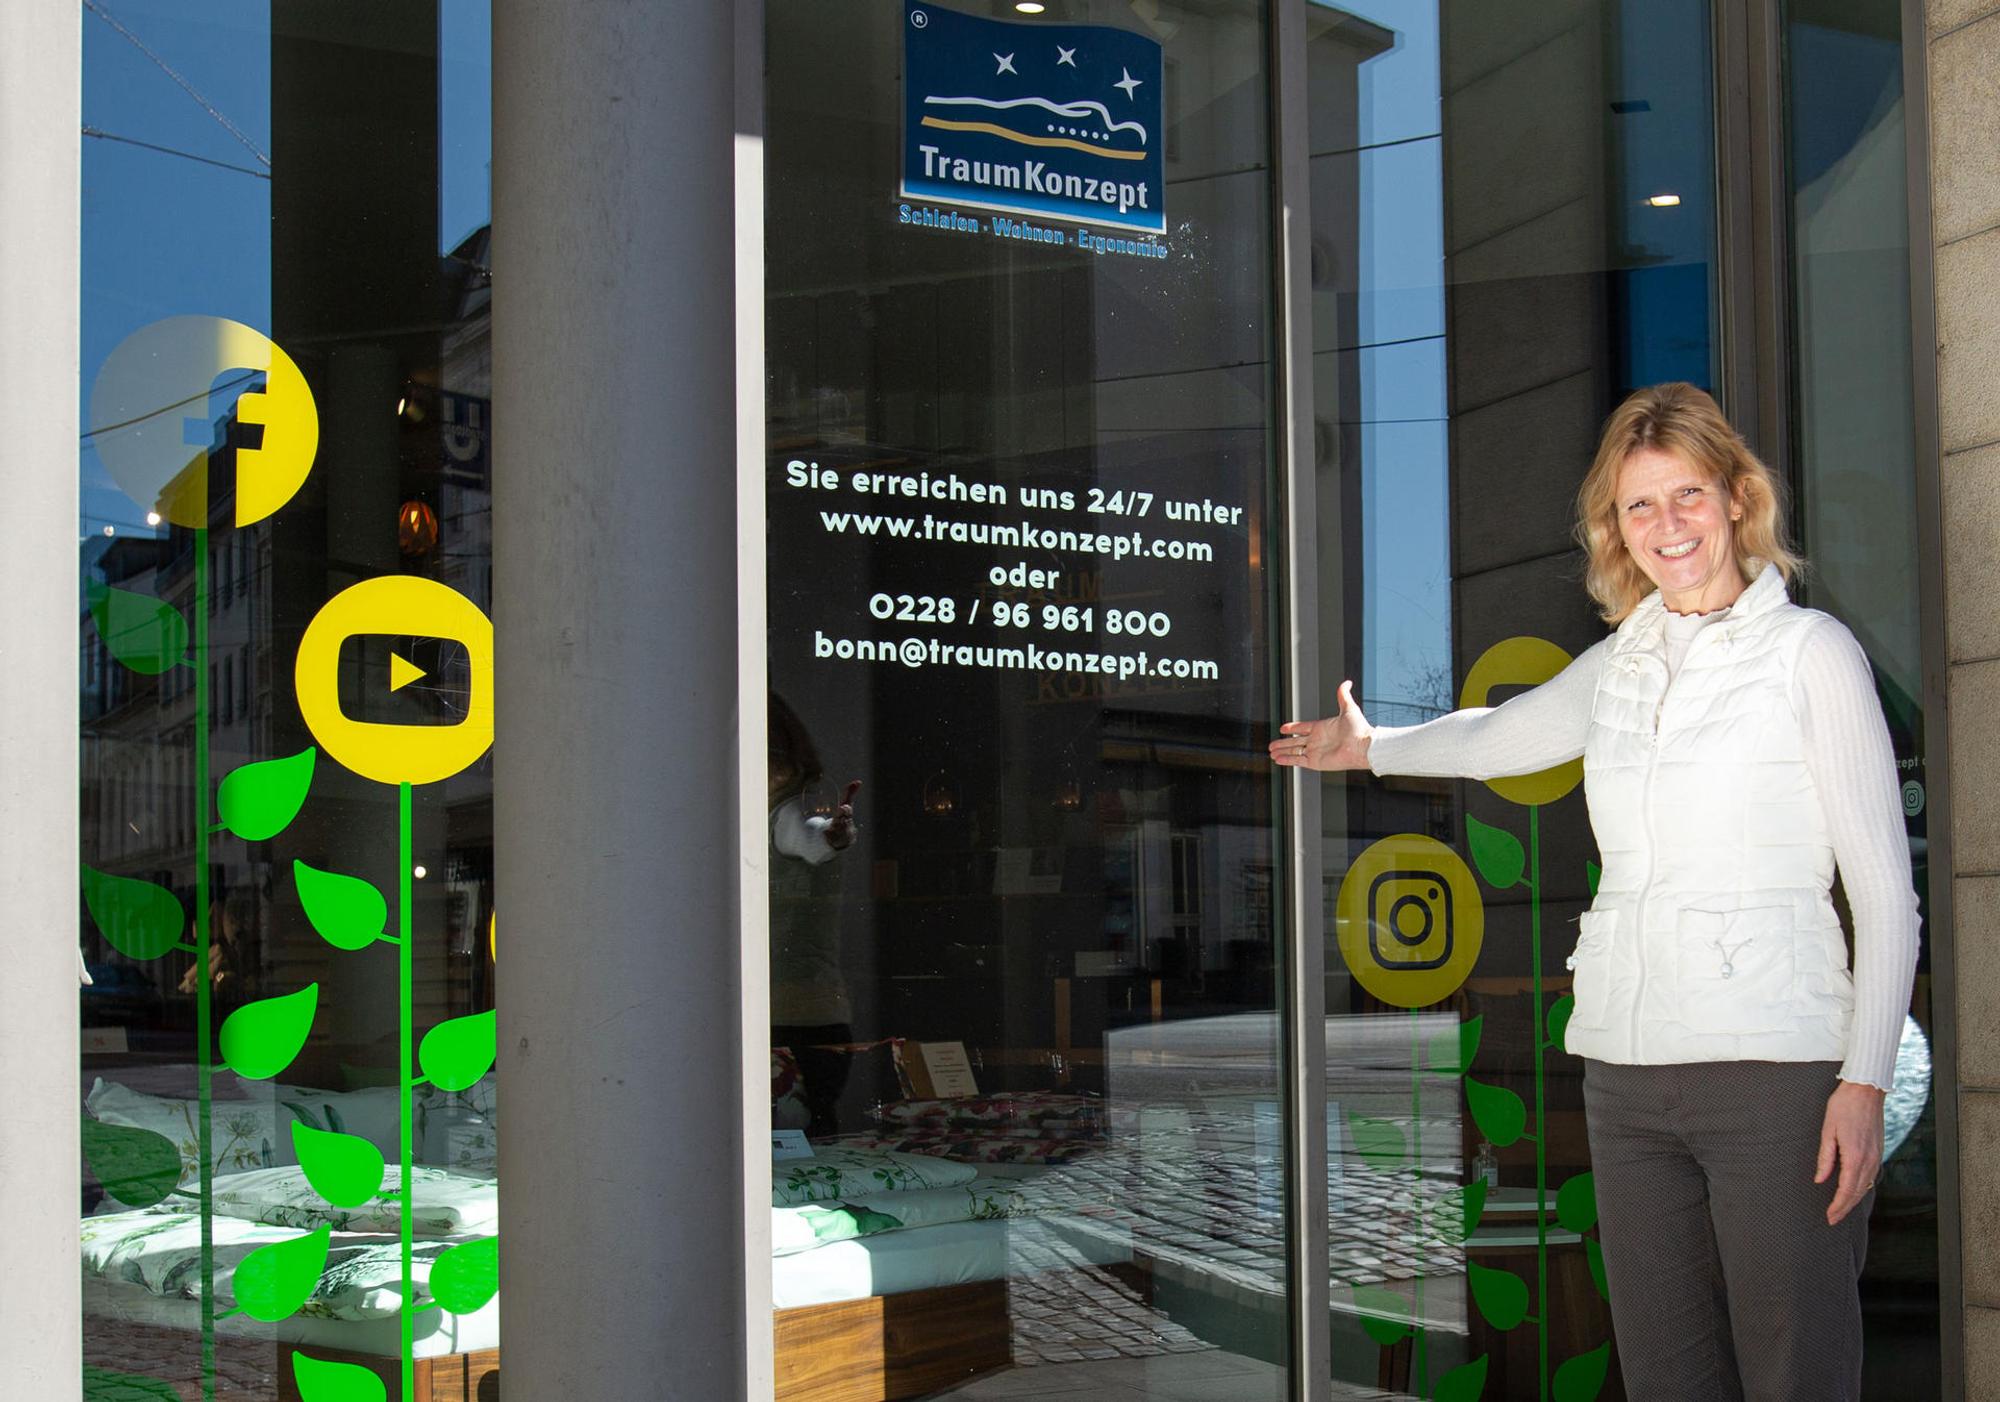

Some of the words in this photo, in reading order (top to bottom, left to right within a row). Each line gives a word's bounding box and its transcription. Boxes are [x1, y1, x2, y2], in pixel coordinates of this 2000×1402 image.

[919, 145, 1148, 213] TraumKonzept
[899, 204, 979, 233] Schlafen
[992, 217, 1064, 245] Wohnen
[1078, 229, 1168, 259] Ergonomie
[786, 460, 839, 490] Sie
[852, 472, 1007, 505] erreichen
[1020, 487, 1075, 511] uns
[1087, 488, 1154, 517] 24/7
[1165, 498, 1243, 526] unter
[819, 511, 1213, 562] www.traumkonzept.com
[989, 561, 1060, 590] oder
[869, 593, 956, 624] 0228
[992, 601, 1030, 629] 96
[1042, 604, 1093, 633] 961
[1105, 609, 1171, 637] 800
[815, 630, 1219, 681] bonn@traumkonzept.com
